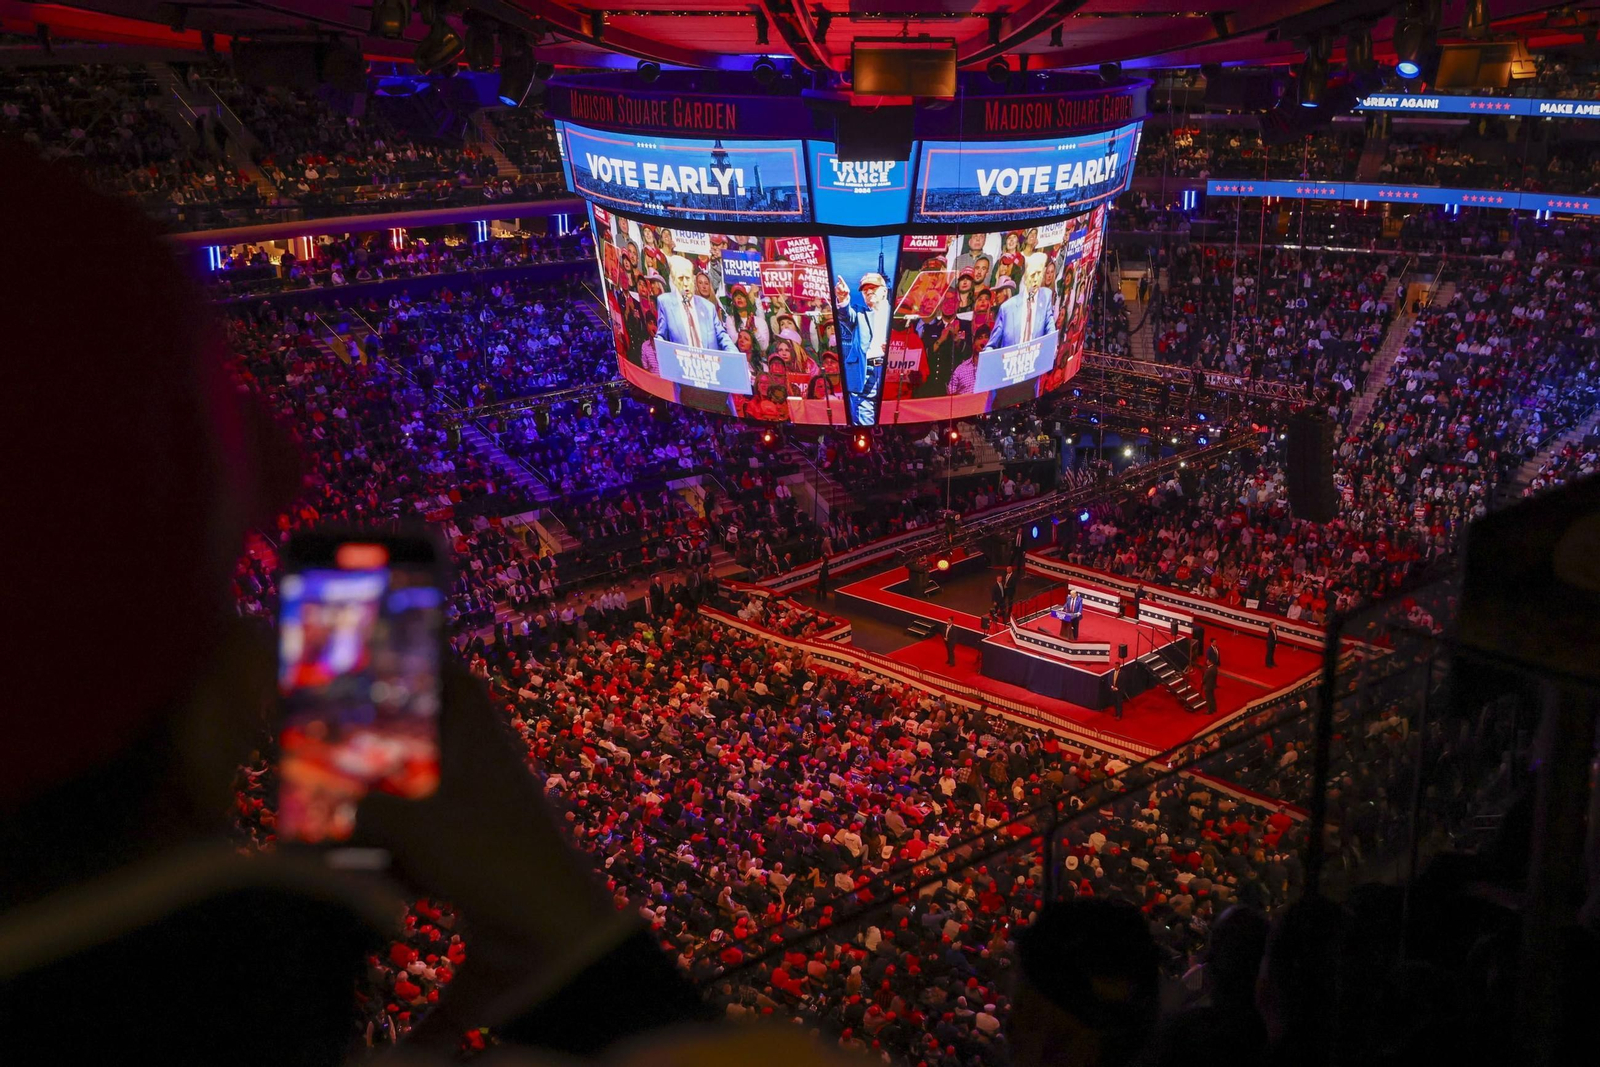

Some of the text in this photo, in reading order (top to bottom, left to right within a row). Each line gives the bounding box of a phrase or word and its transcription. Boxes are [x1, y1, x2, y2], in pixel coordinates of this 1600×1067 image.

[1400, 98, 1439, 108] AGAIN!
[1540, 103, 1574, 114] MAKE
[570, 89, 736, 130] MADISON SQUARE GARDEN
[985, 94, 1134, 131] MADISON SQUARE GARDEN
[829, 158, 896, 173] TRUMP
[585, 152, 746, 196] VOTE EARLY!
[837, 171, 889, 183] VANCE
[976, 153, 1119, 197] VOTE EARLY!
[674, 230, 706, 239] TRUMP
[787, 238, 810, 247] MAKE
[909, 239, 939, 247] AGAIN!
[784, 244, 819, 255] AMERICA
[789, 251, 815, 262] GREAT
[723, 259, 760, 271] TRUMP
[724, 267, 741, 276] WILL
[763, 271, 793, 282] TRU
[764, 279, 783, 288] WILL
